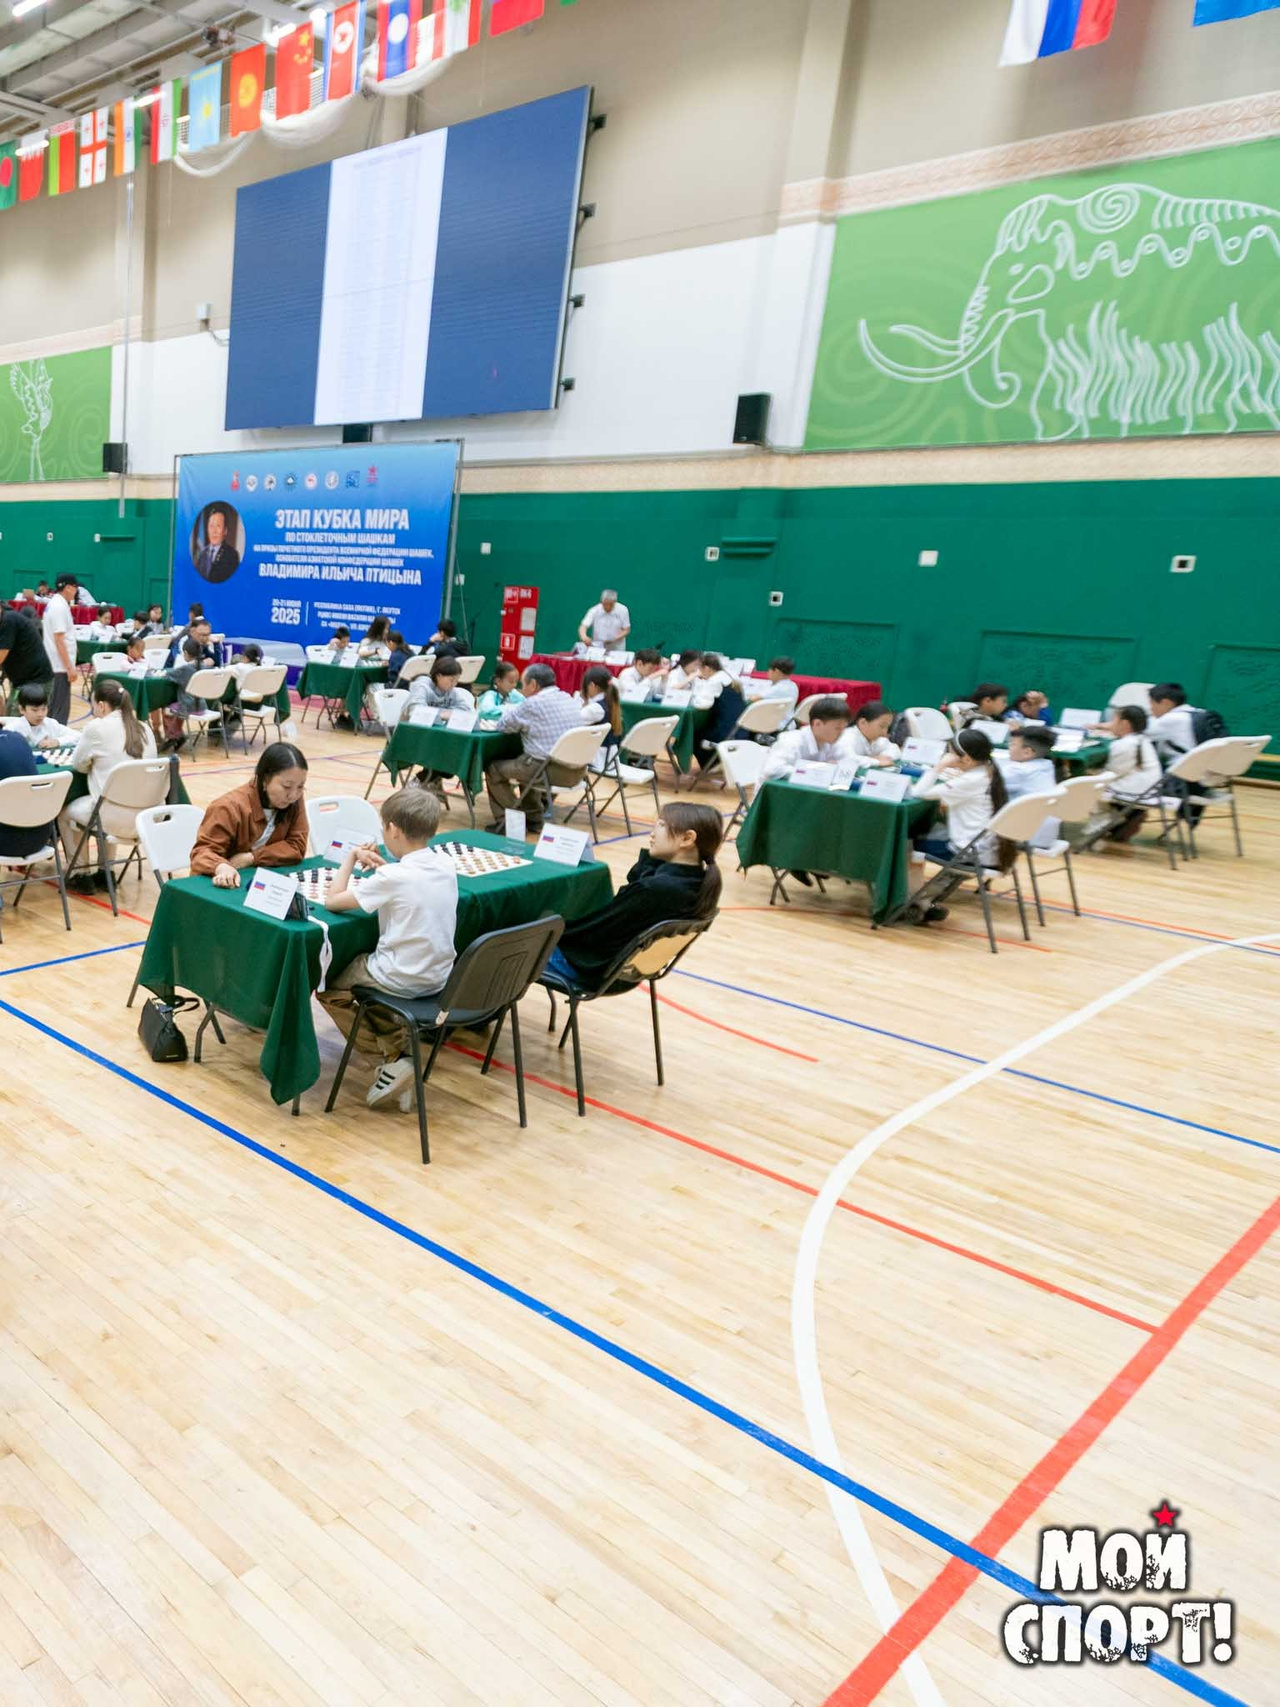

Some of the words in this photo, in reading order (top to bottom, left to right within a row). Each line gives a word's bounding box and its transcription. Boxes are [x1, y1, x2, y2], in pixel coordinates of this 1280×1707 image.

[275, 509, 310, 528] ЭТАП
[312, 509, 362, 529] КУБКА
[364, 509, 410, 530] МИРА
[285, 532, 296, 542] ПО
[296, 532, 357, 544] СТОКЛЕТОЧНЫМ
[357, 533, 396, 545] ШАШКАМ
[259, 563, 320, 579] ВЛАДИМИРА
[321, 565, 364, 582] ИЛЬИЧА
[366, 568, 422, 586] ПТИЦЫНА
[271, 607, 300, 625] 2025
